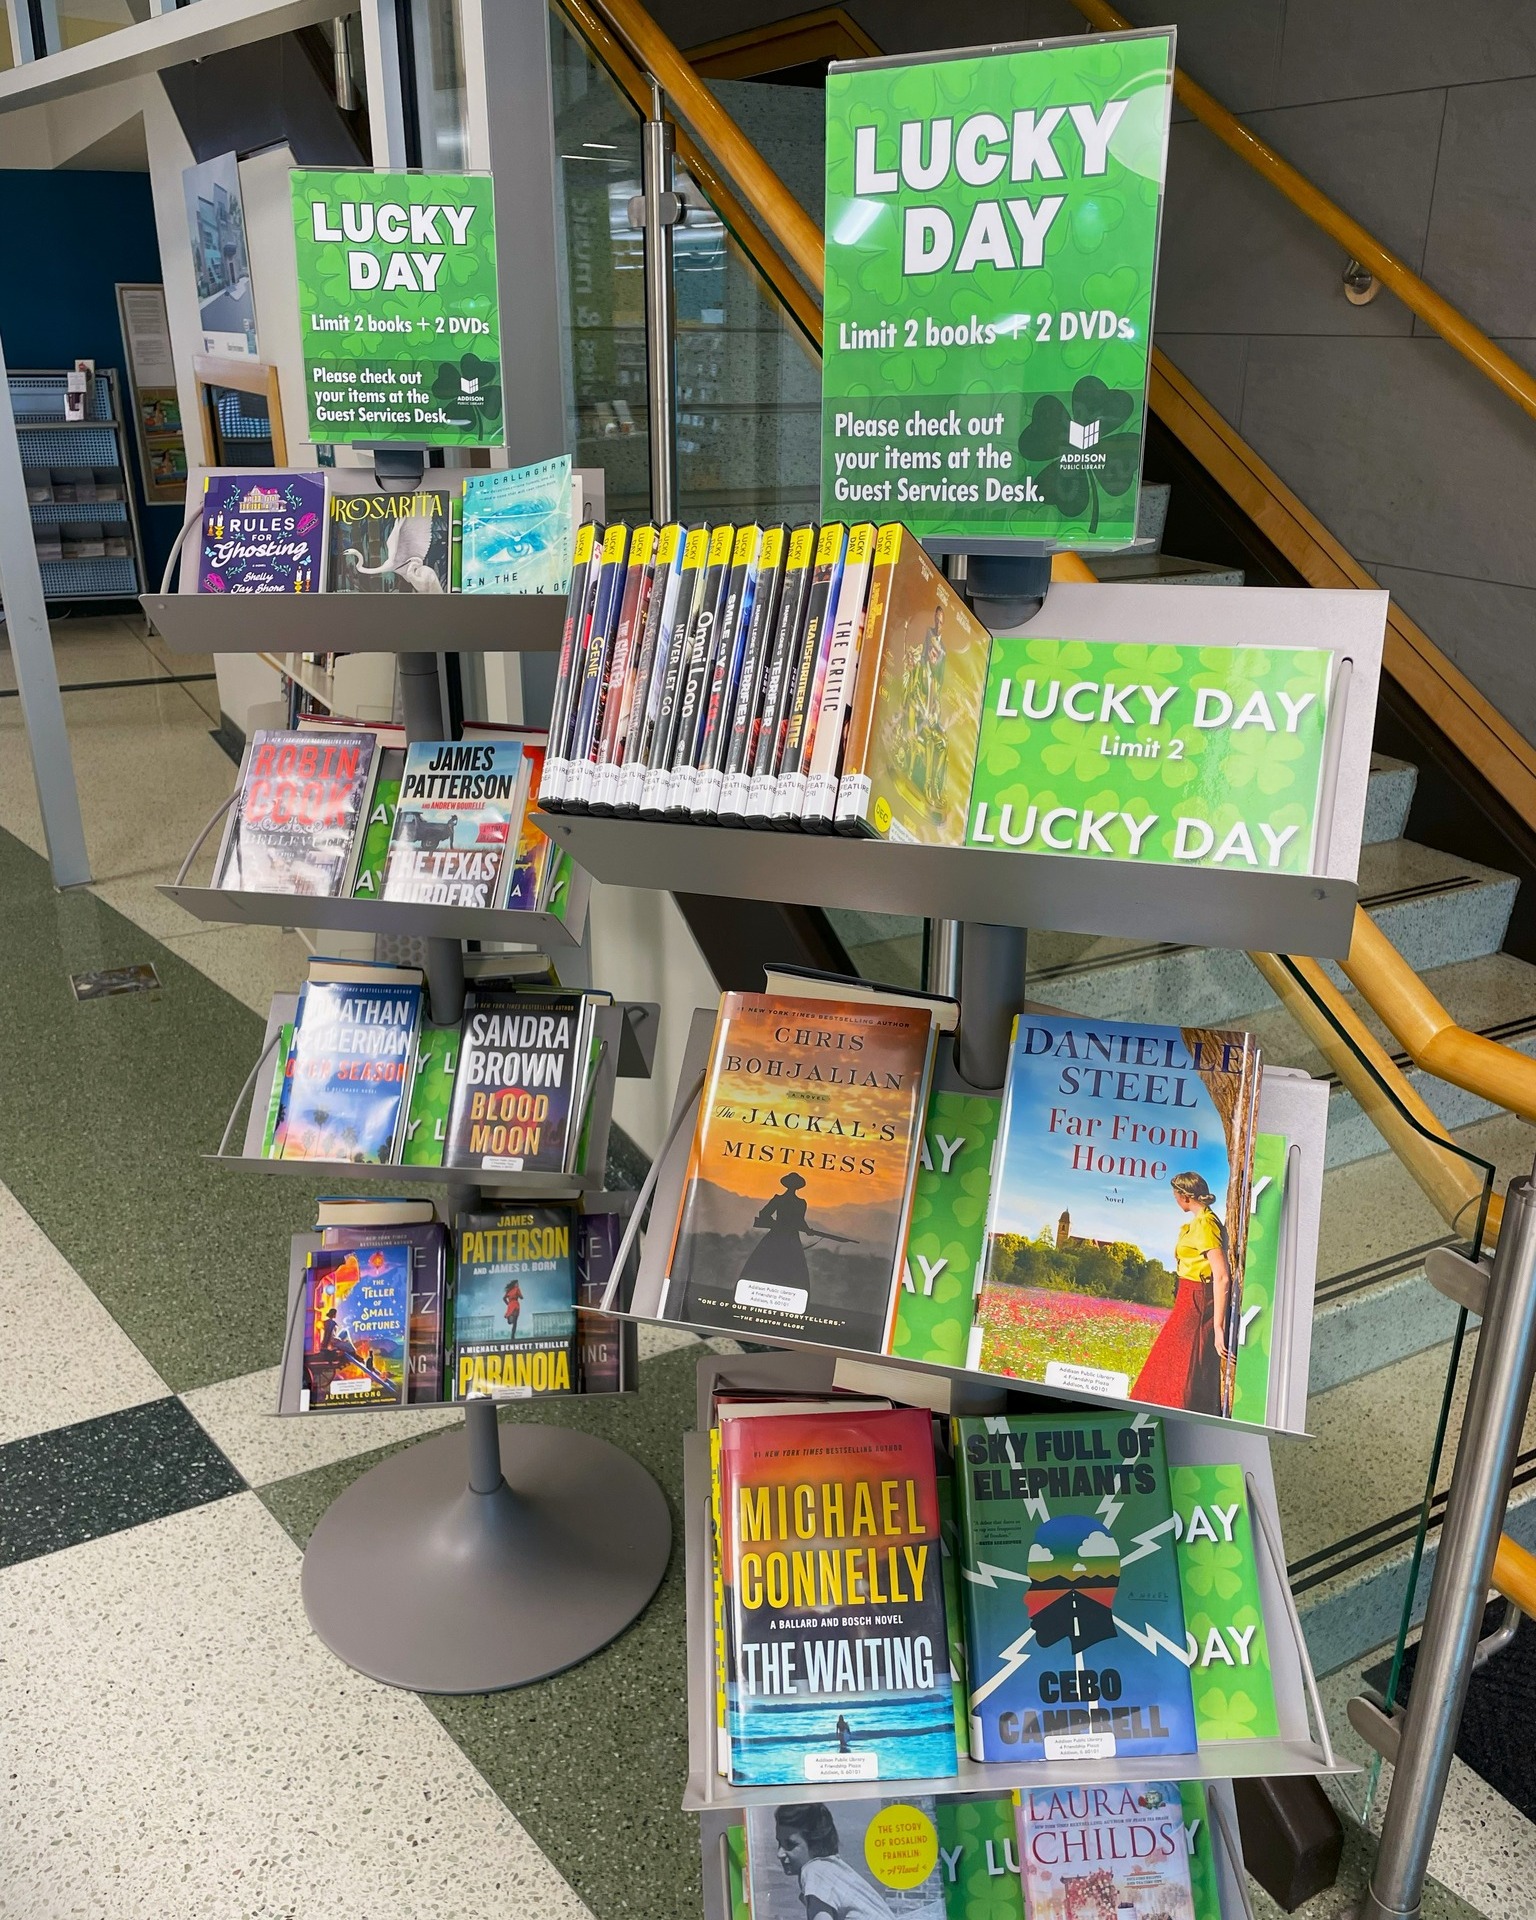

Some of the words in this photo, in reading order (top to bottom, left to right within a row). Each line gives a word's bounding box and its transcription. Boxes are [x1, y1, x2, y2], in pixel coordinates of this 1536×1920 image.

[854, 98, 1131, 198] LUCKY
[312, 202, 477, 245] LUCKY
[902, 193, 1069, 277] DAY
[348, 251, 446, 292] DAY
[312, 314, 350, 331] Limit
[354, 316, 364, 332] 2
[368, 315, 412, 333] books
[435, 317, 445, 333] 2
[449, 318, 490, 334] DVDs
[839, 321, 897, 350] Limit
[904, 319, 918, 348] 2
[926, 315, 996, 347] books
[1035, 313, 1051, 342] 2
[1060, 310, 1131, 341] DVDs
[313, 367, 357, 384] Please
[360, 367, 396, 384] check
[400, 370, 422, 385] out
[314, 390, 346, 406] your
[348, 388, 385, 403] items
[388, 390, 403, 404] at
[406, 388, 430, 404] the
[316, 407, 355, 422] Guest
[359, 407, 411, 423] Services
[414, 408, 451, 424] Desk.
[834, 411, 902, 438] Please
[905, 409, 961, 437] check
[968, 412, 1005, 436] out
[834, 449, 881, 475] your
[885, 444, 942, 470] items
[948, 446, 970, 469] at
[977, 443, 1012, 468] the
[1060, 453, 1106, 464] ADDISON
[469, 481, 484, 489] JO
[493, 461, 566, 485] CALLAGHAN
[834, 477, 892, 502] Guest
[897, 476, 979, 503] Services
[986, 476, 1045, 503] Desk.
[230, 517, 295, 532] RULES
[335, 495, 443, 525] ROSARITA
[211, 540, 308, 568] Ghosting
[823, 531, 833, 556] LUCKY
[849, 536, 857, 553] DAY
[858, 530, 867, 557] LUCKY
[876, 536, 884, 554] DAY
[883, 529, 893, 556] LUCKY
[243, 572, 274, 583] Shelly
[255, 583, 285, 593] Shore
[466, 578, 485, 587] IN
[495, 572, 518, 584] THE
[722, 594, 736, 639] SMILE
[669, 623, 685, 664] NEVER
[690, 611, 714, 665] Omni
[834, 620, 852, 648] THE
[587, 636, 604, 678] GENIE
[795, 616, 819, 714] TRANSFORMERS
[665, 670, 677, 691] LET
[682, 667, 704, 718] Loop
[736, 656, 755, 726] TERRIFIER
[762, 657, 783, 728] TERRIFIER
[823, 657, 846, 712] CRITIC
[661, 697, 672, 716] GO
[995, 677, 1180, 727] LUCKY
[1192, 687, 1316, 733] DAY
[787, 714, 804, 749] ONE
[254, 743, 360, 780] ROBIN
[429, 746, 496, 771] JAMES
[1100, 735, 1161, 759] Limit
[1167, 739, 1185, 760] 2
[402, 774, 513, 799] PATTERSON
[245, 780, 354, 827] COOK
[431, 802, 457, 810] ANDREW
[876, 804, 889, 823] DEC
[972, 802, 1159, 855] LUCKY
[1173, 816, 1300, 867] DAY
[388, 851, 432, 880] THE
[433, 851, 498, 881] TEXAS
[471, 1013, 570, 1049] SANDRA
[792, 1011, 815, 1019] TIMES
[818, 1015, 874, 1025] BESTSELLING
[876, 1020, 910, 1028] AUTHOR
[774, 1027, 865, 1051] CHRIS
[1022, 1026, 1248, 1076] DANIELLE
[467, 1051, 565, 1088] BROWN
[724, 1055, 904, 1091] BOHJALIAN
[1058, 1065, 1199, 1108] STEEL
[470, 1091, 549, 1123] BLOOD
[714, 1106, 735, 1119] The
[742, 1108, 896, 1142] JACKAL'S
[1048, 1107, 1102, 1138] Far
[1111, 1114, 1199, 1150] From
[469, 1125, 541, 1156] MOON
[722, 1140, 876, 1176] MISTRESS
[1070, 1144, 1168, 1182] Home
[1104, 1195, 1125, 1204] Novel
[497, 1214, 534, 1227] JAMES
[462, 1226, 569, 1264] PATTERSON
[473, 1267, 487, 1275] AND
[489, 1263, 519, 1274] JAMES
[532, 1261, 557, 1271] BORN
[361, 1287, 395, 1299] TELLER
[361, 1307, 394, 1321] SMALL
[750, 1306, 777, 1315] FINEST
[352, 1320, 400, 1333] FORTUNES
[466, 1345, 499, 1354] MICHAEL
[500, 1343, 532, 1352] BENNETT
[534, 1341, 569, 1349] THRILLER
[459, 1351, 570, 1396] PARANOIA
[764, 1450, 779, 1458] NEW
[803, 1448, 823, 1456] TIMES
[826, 1446, 873, 1455] BESTSELLING
[966, 1431, 1028, 1465] SKY
[1035, 1428, 1112, 1461] FULL
[1117, 1427, 1156, 1459] OF
[973, 1463, 1157, 1501] ELEPHANTS
[739, 1479, 926, 1542] MICHAEL
[741, 1545, 928, 1610] CONNELLY
[779, 1618, 818, 1629] BALLARD
[821, 1617, 839, 1627] AND
[842, 1616, 872, 1627] BOSCH
[875, 1614, 903, 1625] NOVEL
[742, 1641, 797, 1696] THE
[803, 1635, 935, 1693] WAITING
[1038, 1668, 1122, 1704] CEBO
[999, 1705, 1169, 1746] CAMPBELL
[1029, 1787, 1139, 1821] LAURA
[874, 1838, 887, 1848] OF
[889, 1835, 928, 1847] ROSALIND
[878, 1825, 893, 1834] THE
[895, 1822, 922, 1833] STORY
[882, 1850, 920, 1861] FRANKLIN
[1032, 1822, 1176, 1865] CHILDS
